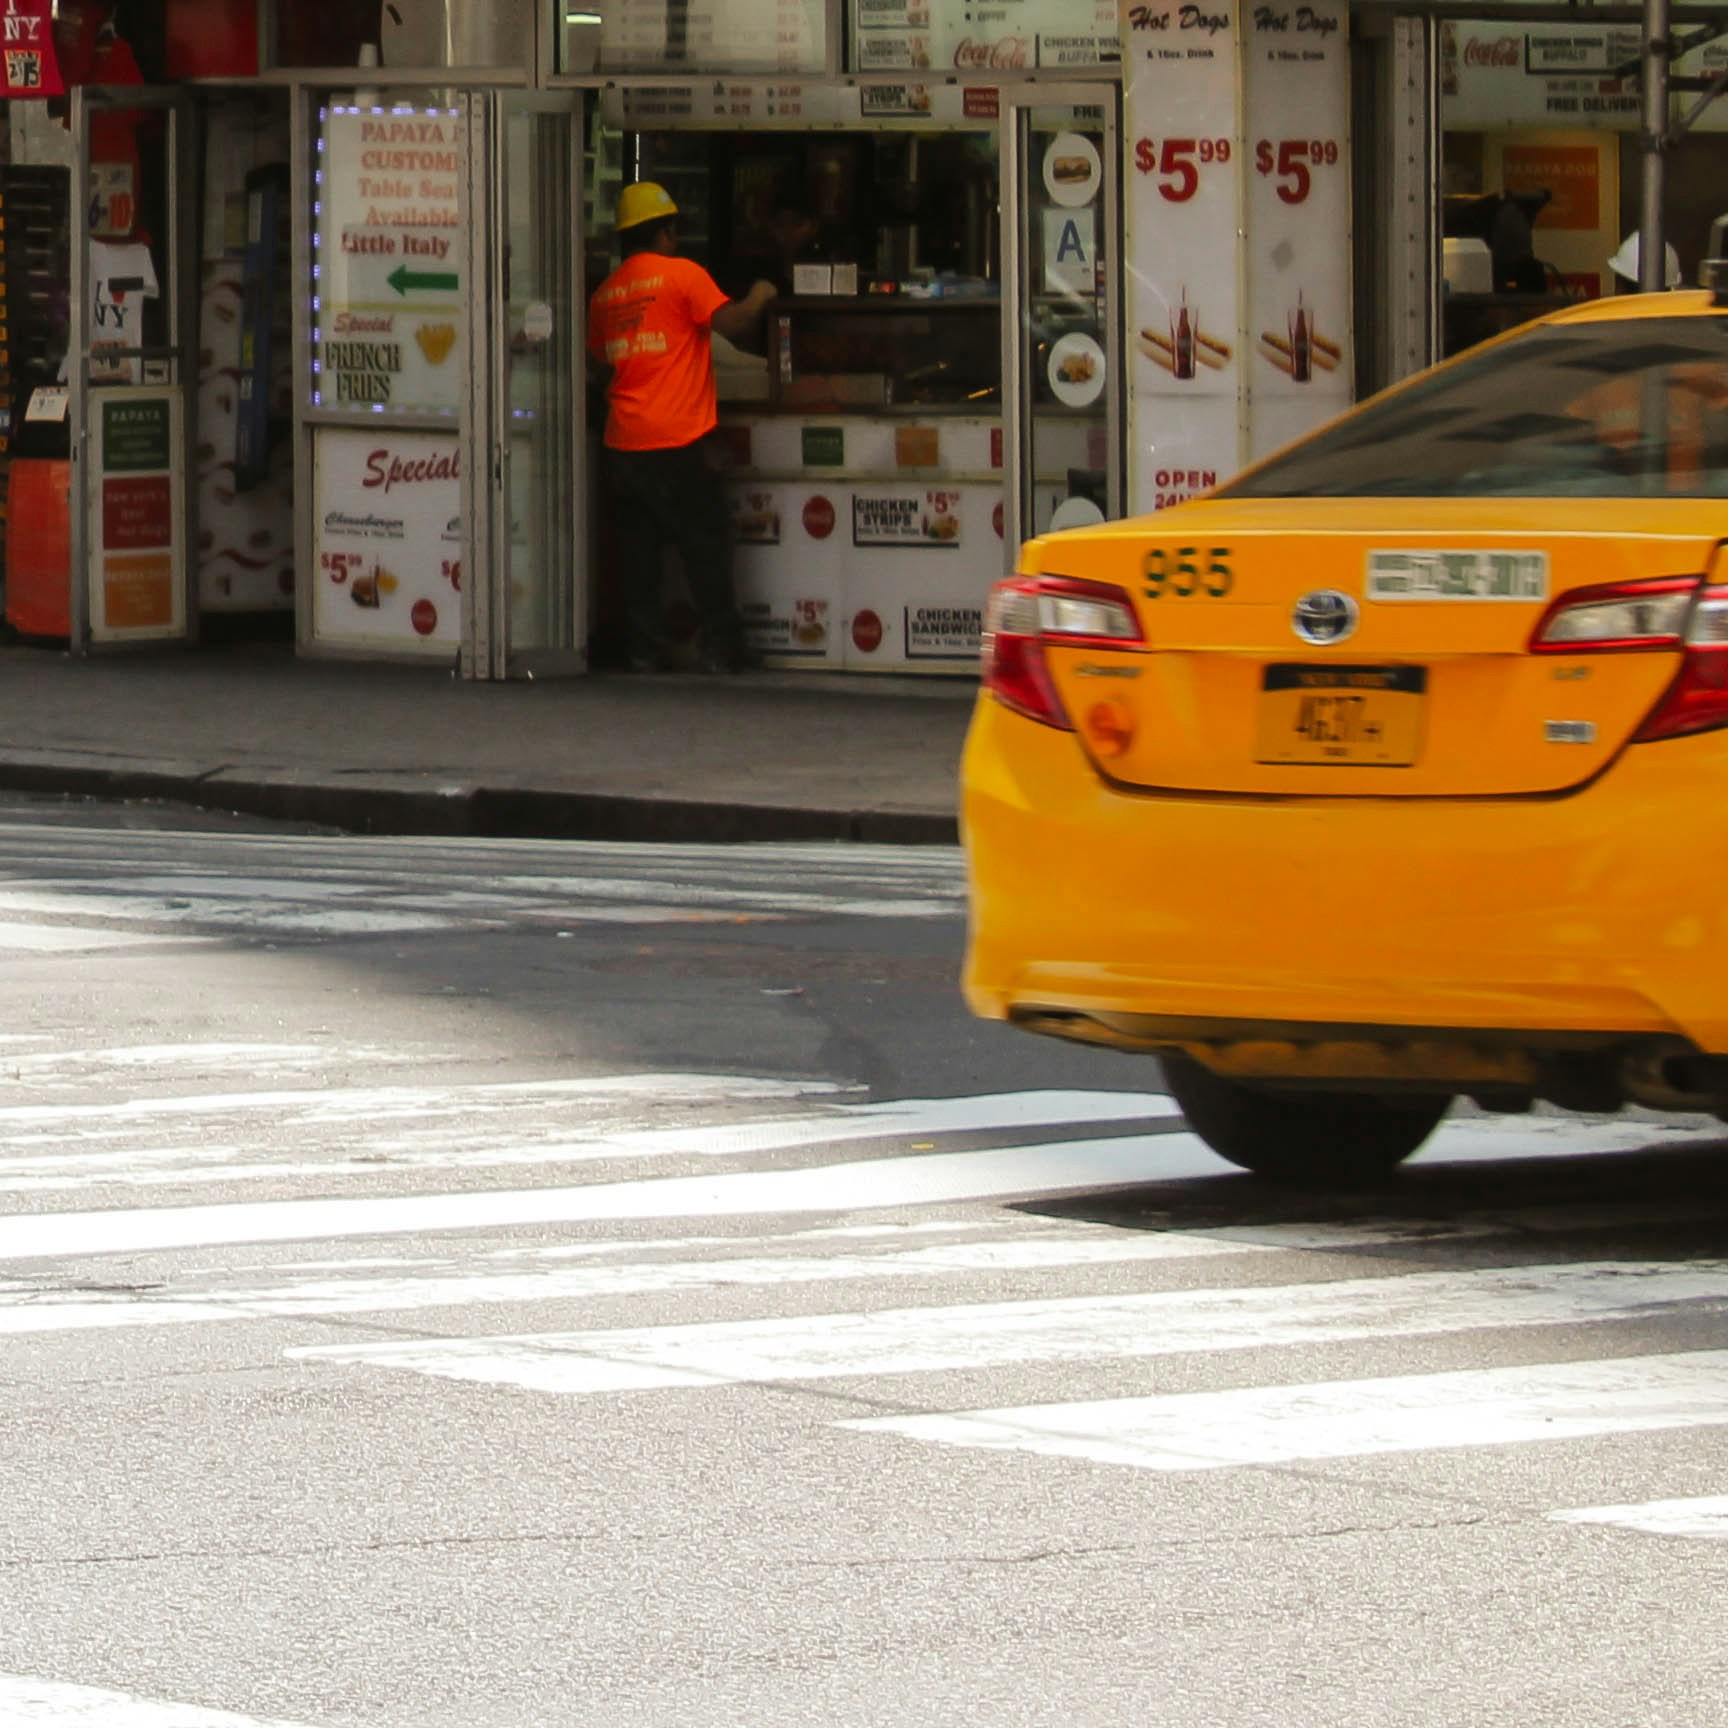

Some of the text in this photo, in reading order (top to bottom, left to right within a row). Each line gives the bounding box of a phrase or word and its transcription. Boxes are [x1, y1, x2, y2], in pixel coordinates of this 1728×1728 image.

[3, 15, 41, 41] NY
[1129, 5, 1230, 37] Hot Dogs
[1254, 6, 1339, 39] Hot Dogs
[1044, 36, 1096, 48] CHICKEN
[1187, 48, 1214, 59] Drink
[1547, 97, 1579, 113] FREE
[360, 122, 443, 144] PAPAYA
[358, 177, 412, 199] Table
[341, 232, 450, 258] Little Italy
[1056, 218, 1086, 262] A
[334, 312, 394, 335] Special
[325, 341, 402, 373] FRENCH
[335, 372, 391, 402] FRIES
[111, 409, 161, 424] PAPAYA
[362, 447, 460, 494] Special
[1155, 470, 1217, 489] OPEN
[855, 498, 918, 513] CHICKEN
[863, 513, 912, 526] STRIPS
[1144, 546, 1234, 600] 955
[916, 608, 982, 622] CHICKEN
